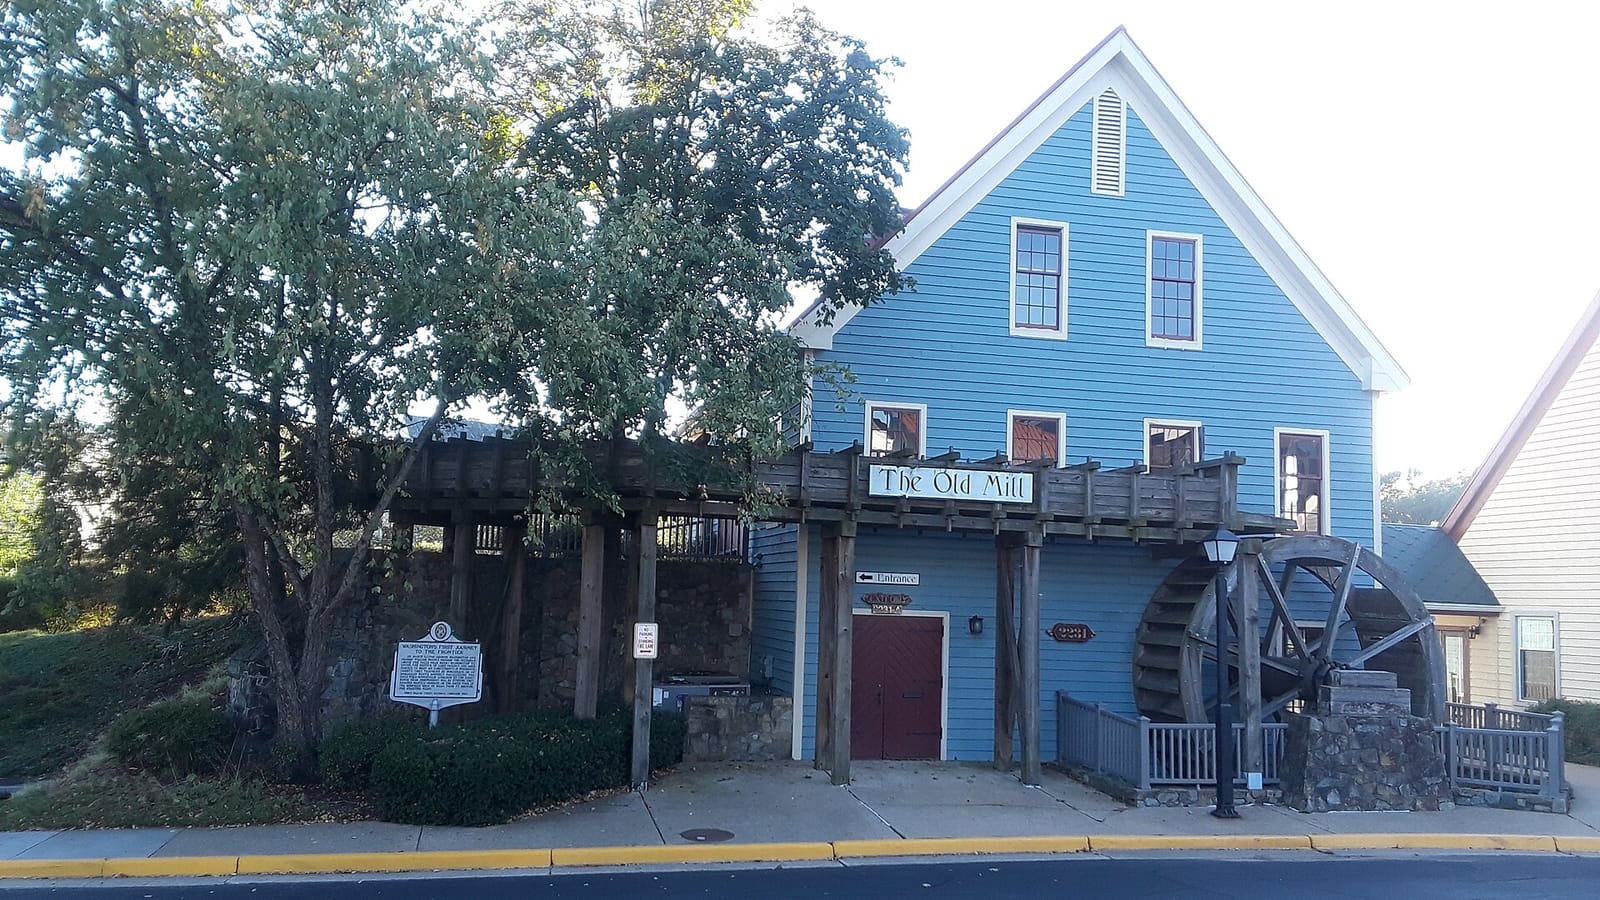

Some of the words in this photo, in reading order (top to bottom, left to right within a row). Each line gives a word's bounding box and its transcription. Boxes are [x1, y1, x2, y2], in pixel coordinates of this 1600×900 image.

[879, 468, 922, 493] The
[934, 470, 970, 495] Old
[982, 474, 1024, 498] Mill
[878, 574, 916, 583] Entrance
[1058, 627, 1087, 639] 2231
